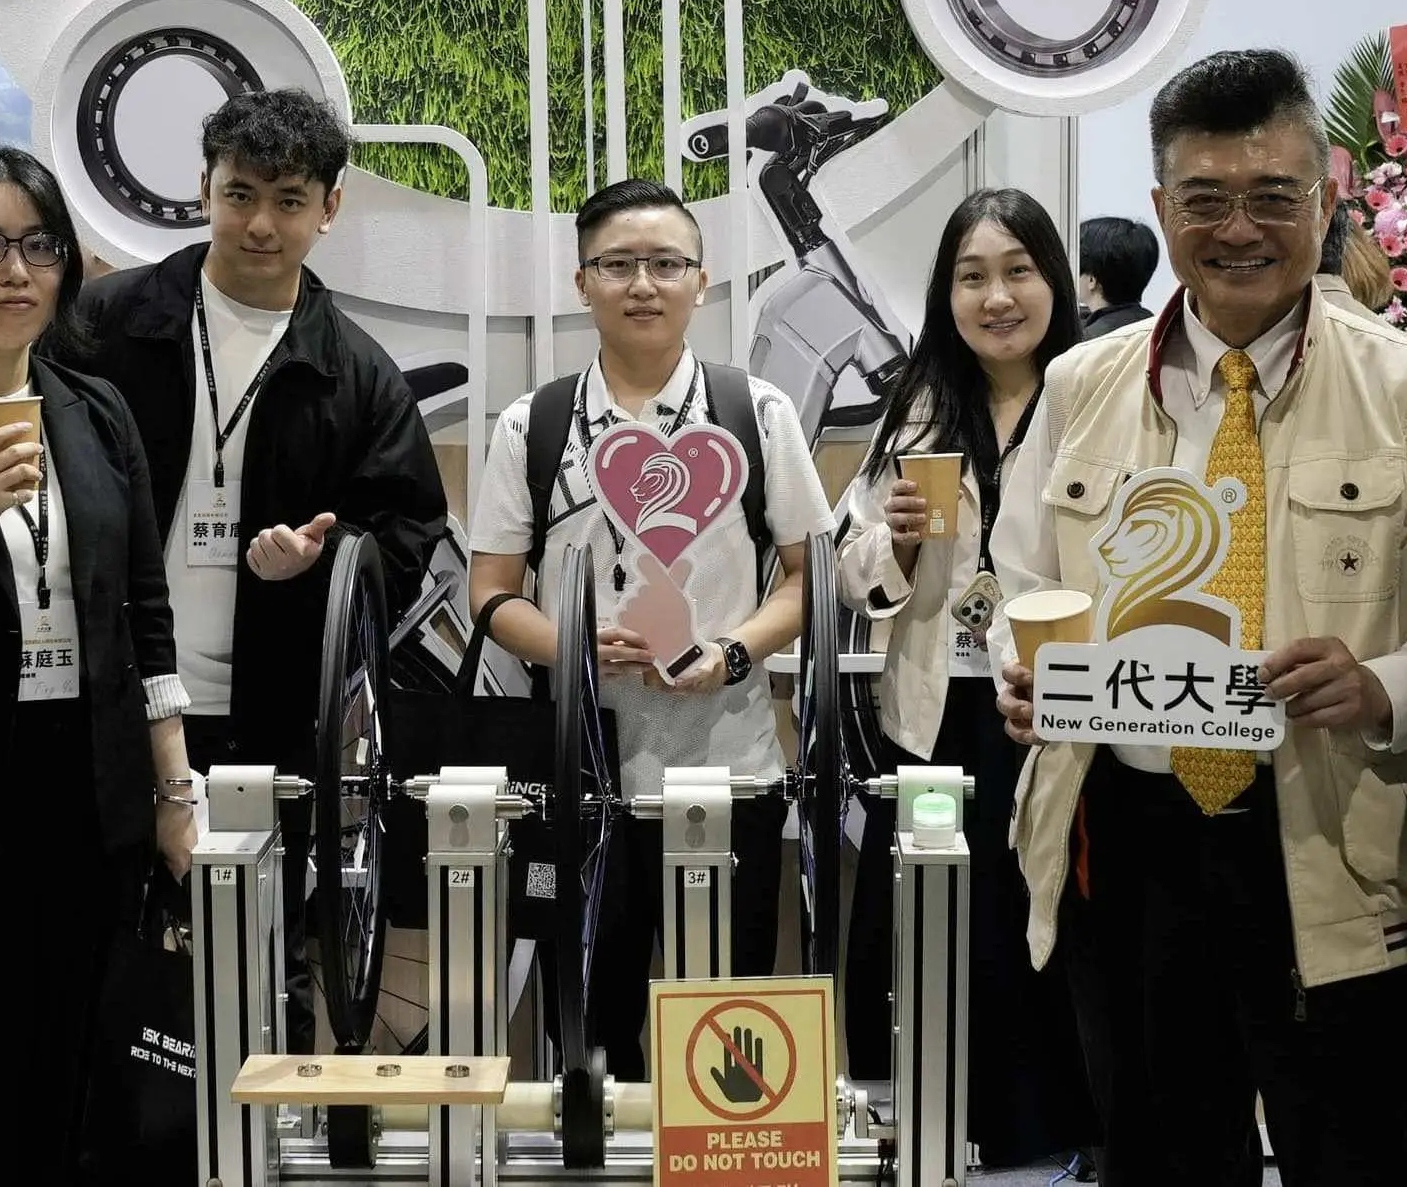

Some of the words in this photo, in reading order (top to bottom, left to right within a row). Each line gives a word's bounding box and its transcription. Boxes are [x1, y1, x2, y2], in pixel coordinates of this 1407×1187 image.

[1042, 659, 1276, 715] 二代大學
[1041, 714, 1083, 731] New
[1089, 716, 1194, 735] Generation
[1201, 721, 1275, 741] College
[214, 869, 232, 882] 1#
[452, 870, 470, 884] 2#
[687, 870, 706, 884] 3#
[707, 1130, 783, 1150] PLEASE
[669, 1154, 698, 1172] DO
[704, 1153, 745, 1171] NOT
[751, 1150, 821, 1169] TOUCH
